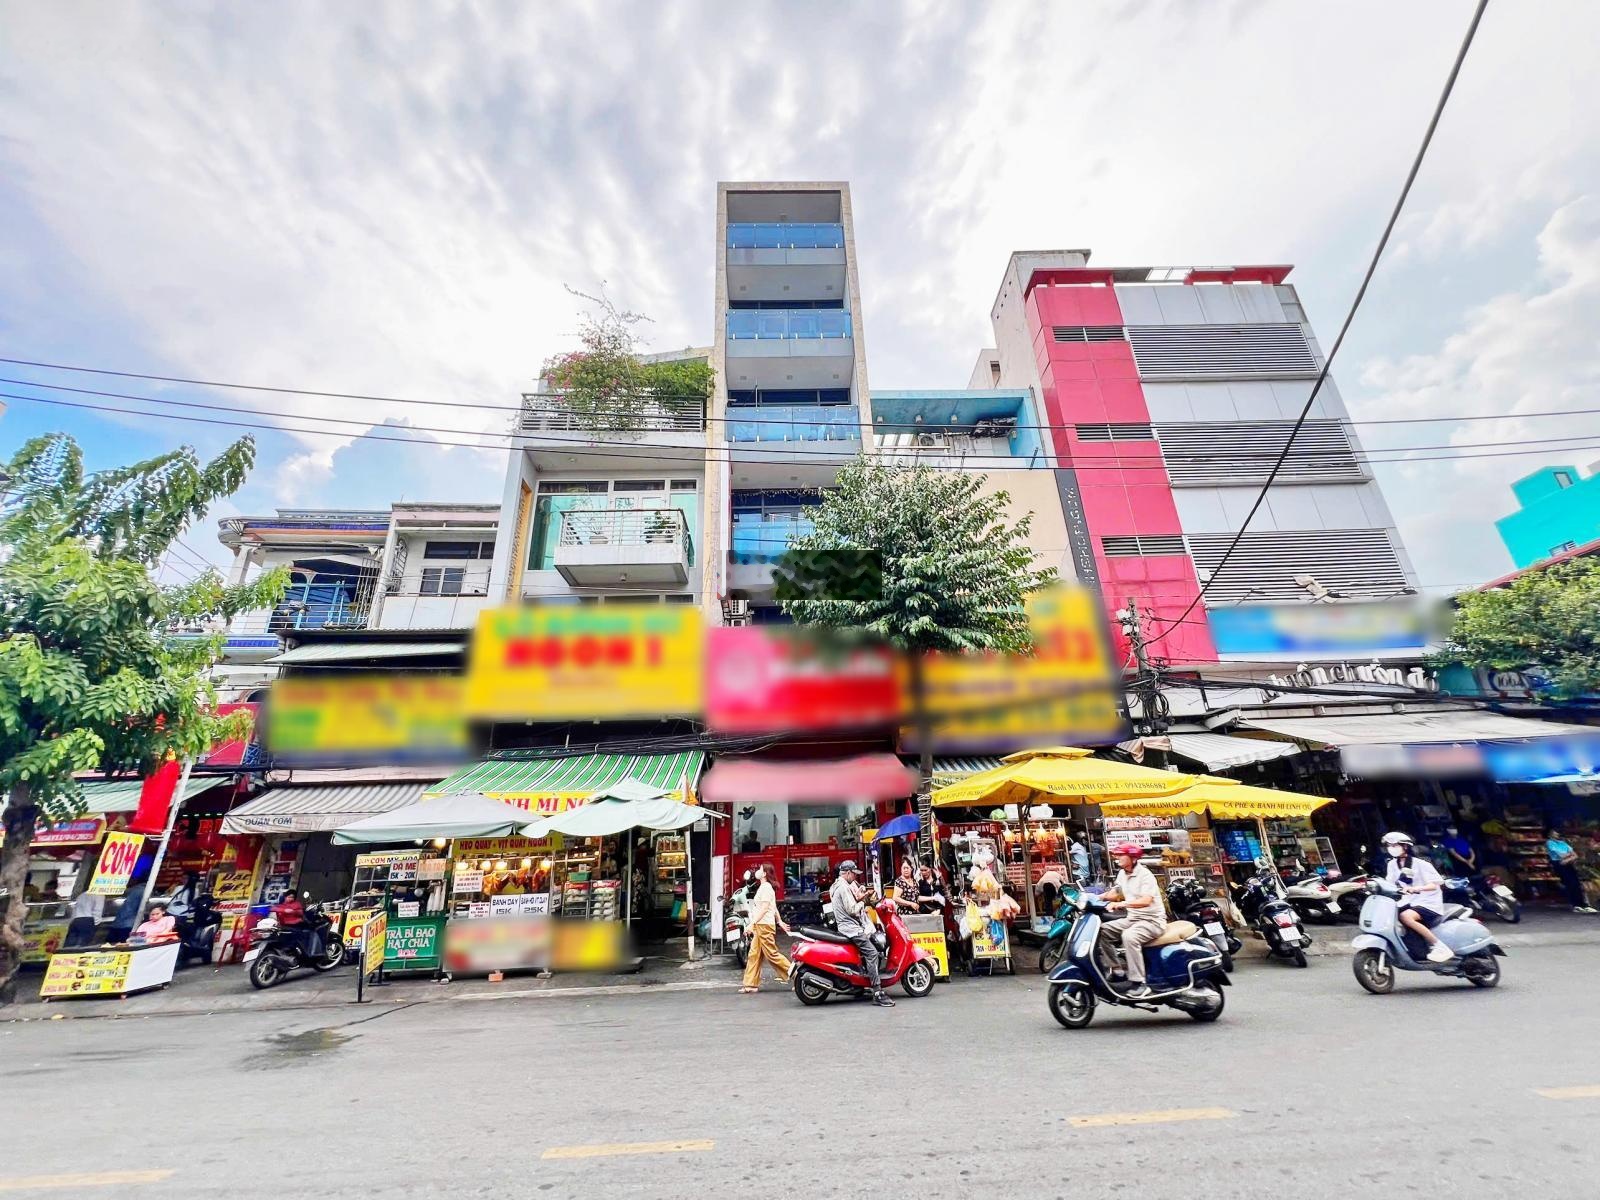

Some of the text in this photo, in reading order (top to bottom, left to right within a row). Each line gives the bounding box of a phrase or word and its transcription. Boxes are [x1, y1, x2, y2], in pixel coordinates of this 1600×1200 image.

[460, 840, 473, 850] HEO
[474, 840, 492, 850] QUAY
[510, 839, 526, 848] QUAY
[404, 926, 415, 938] BÍ
[407, 937, 430, 949] CHIA
